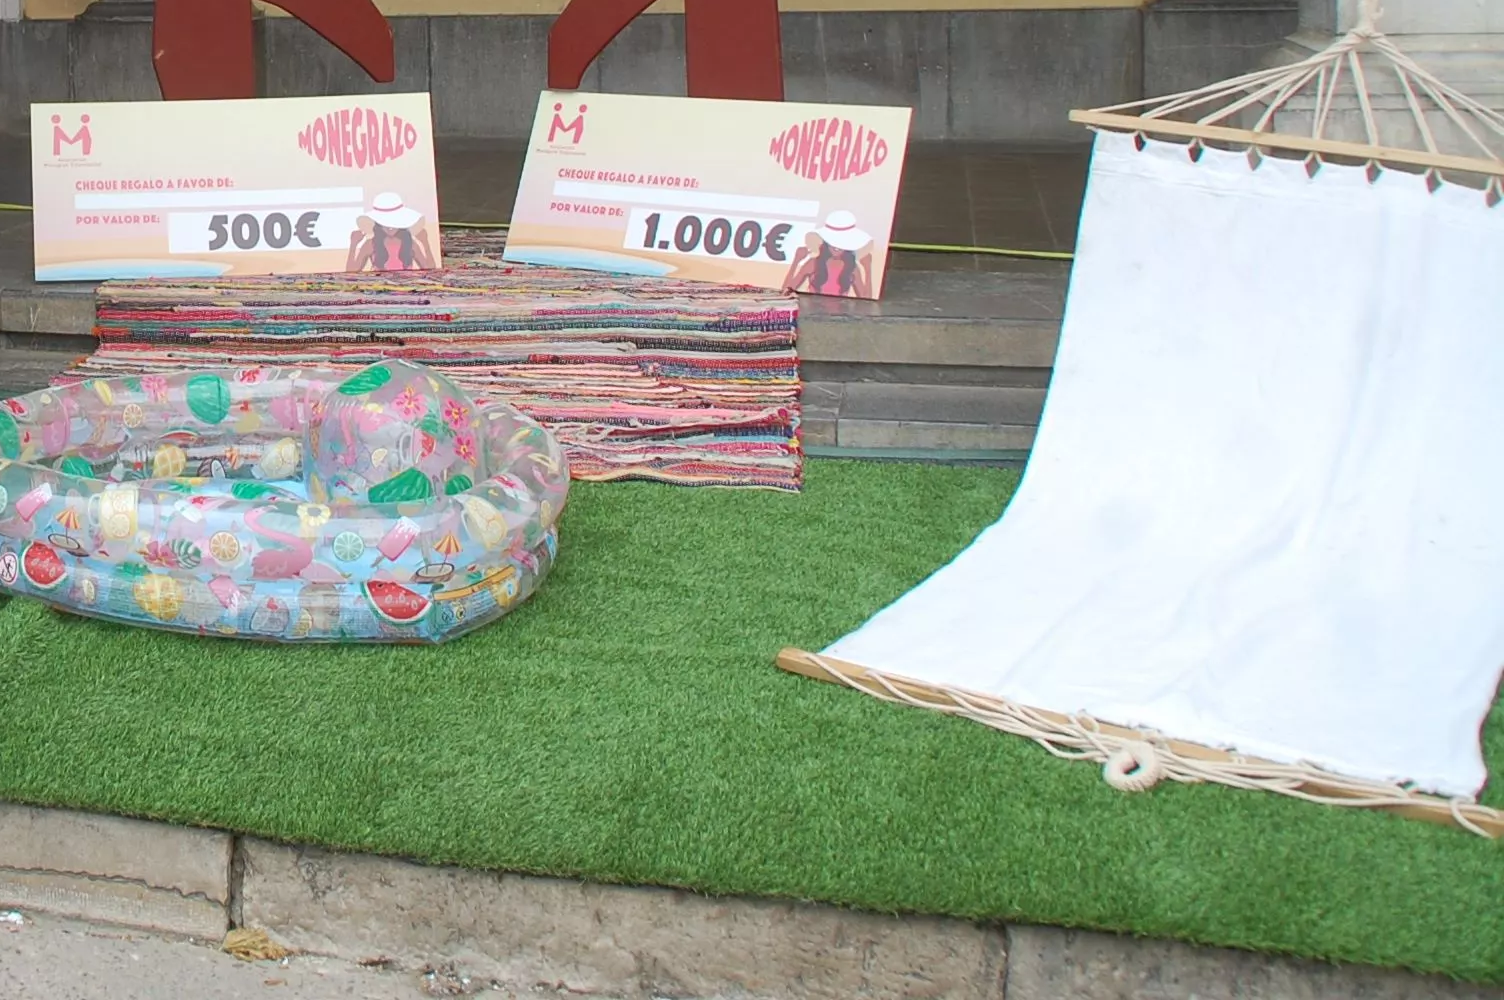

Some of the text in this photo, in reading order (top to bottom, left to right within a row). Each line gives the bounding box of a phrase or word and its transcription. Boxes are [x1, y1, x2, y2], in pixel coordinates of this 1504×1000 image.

[298, 106, 417, 169] MONEGRAZO
[769, 117, 889, 183] MONEGRAZO
[75, 177, 234, 191] CHEQUE REGALO A FAVOR DE:
[558, 168, 700, 189] CHEQUE REGALO A FAVOR DE:
[76, 214, 161, 225] POR VALOR DE:
[550, 202, 624, 217] POR VALOR DE:
[207, 211, 322, 251] 500€
[643, 212, 793, 262] 1.000€
